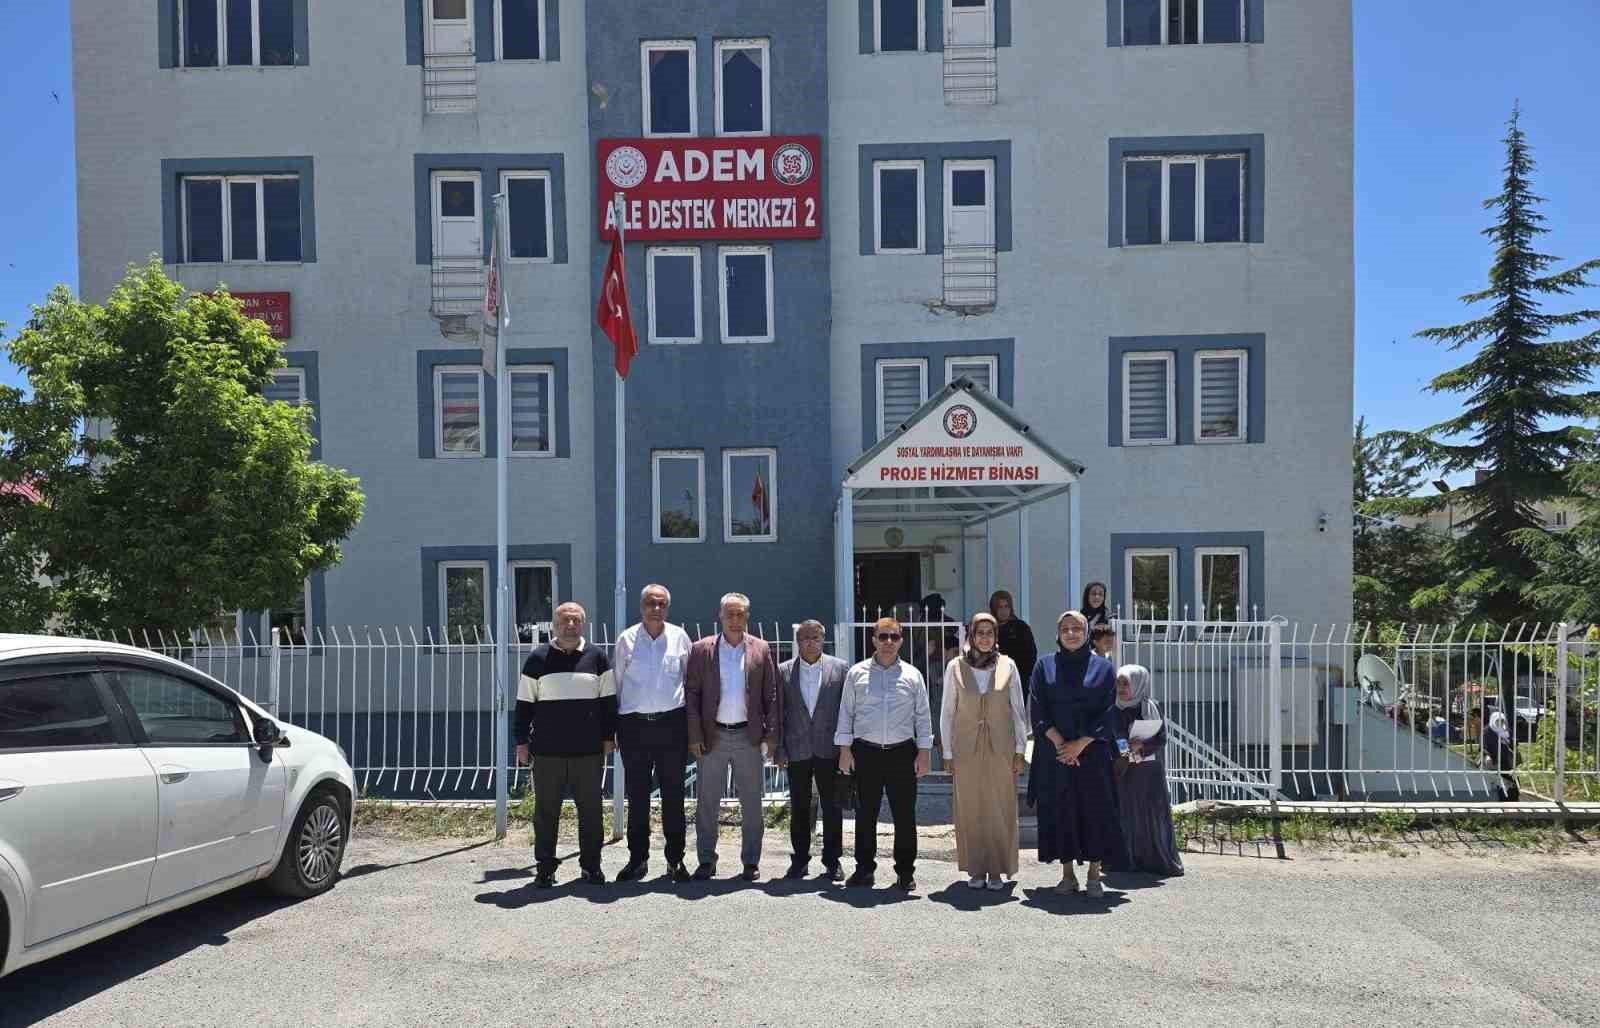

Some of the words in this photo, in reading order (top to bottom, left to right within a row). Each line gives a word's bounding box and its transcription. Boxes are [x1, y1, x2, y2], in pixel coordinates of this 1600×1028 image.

[653, 148, 765, 183] ADEM
[604, 199, 642, 230] ALE
[648, 198, 716, 229] DESTEK
[723, 197, 797, 228] MERKEZİ
[804, 197, 816, 227] 2
[896, 447, 919, 458] SOSYAL
[962, 446, 972, 457] VE
[880, 466, 927, 481] PROJE
[930, 463, 986, 480] HİZMET
[988, 463, 1039, 480] BİNASI
